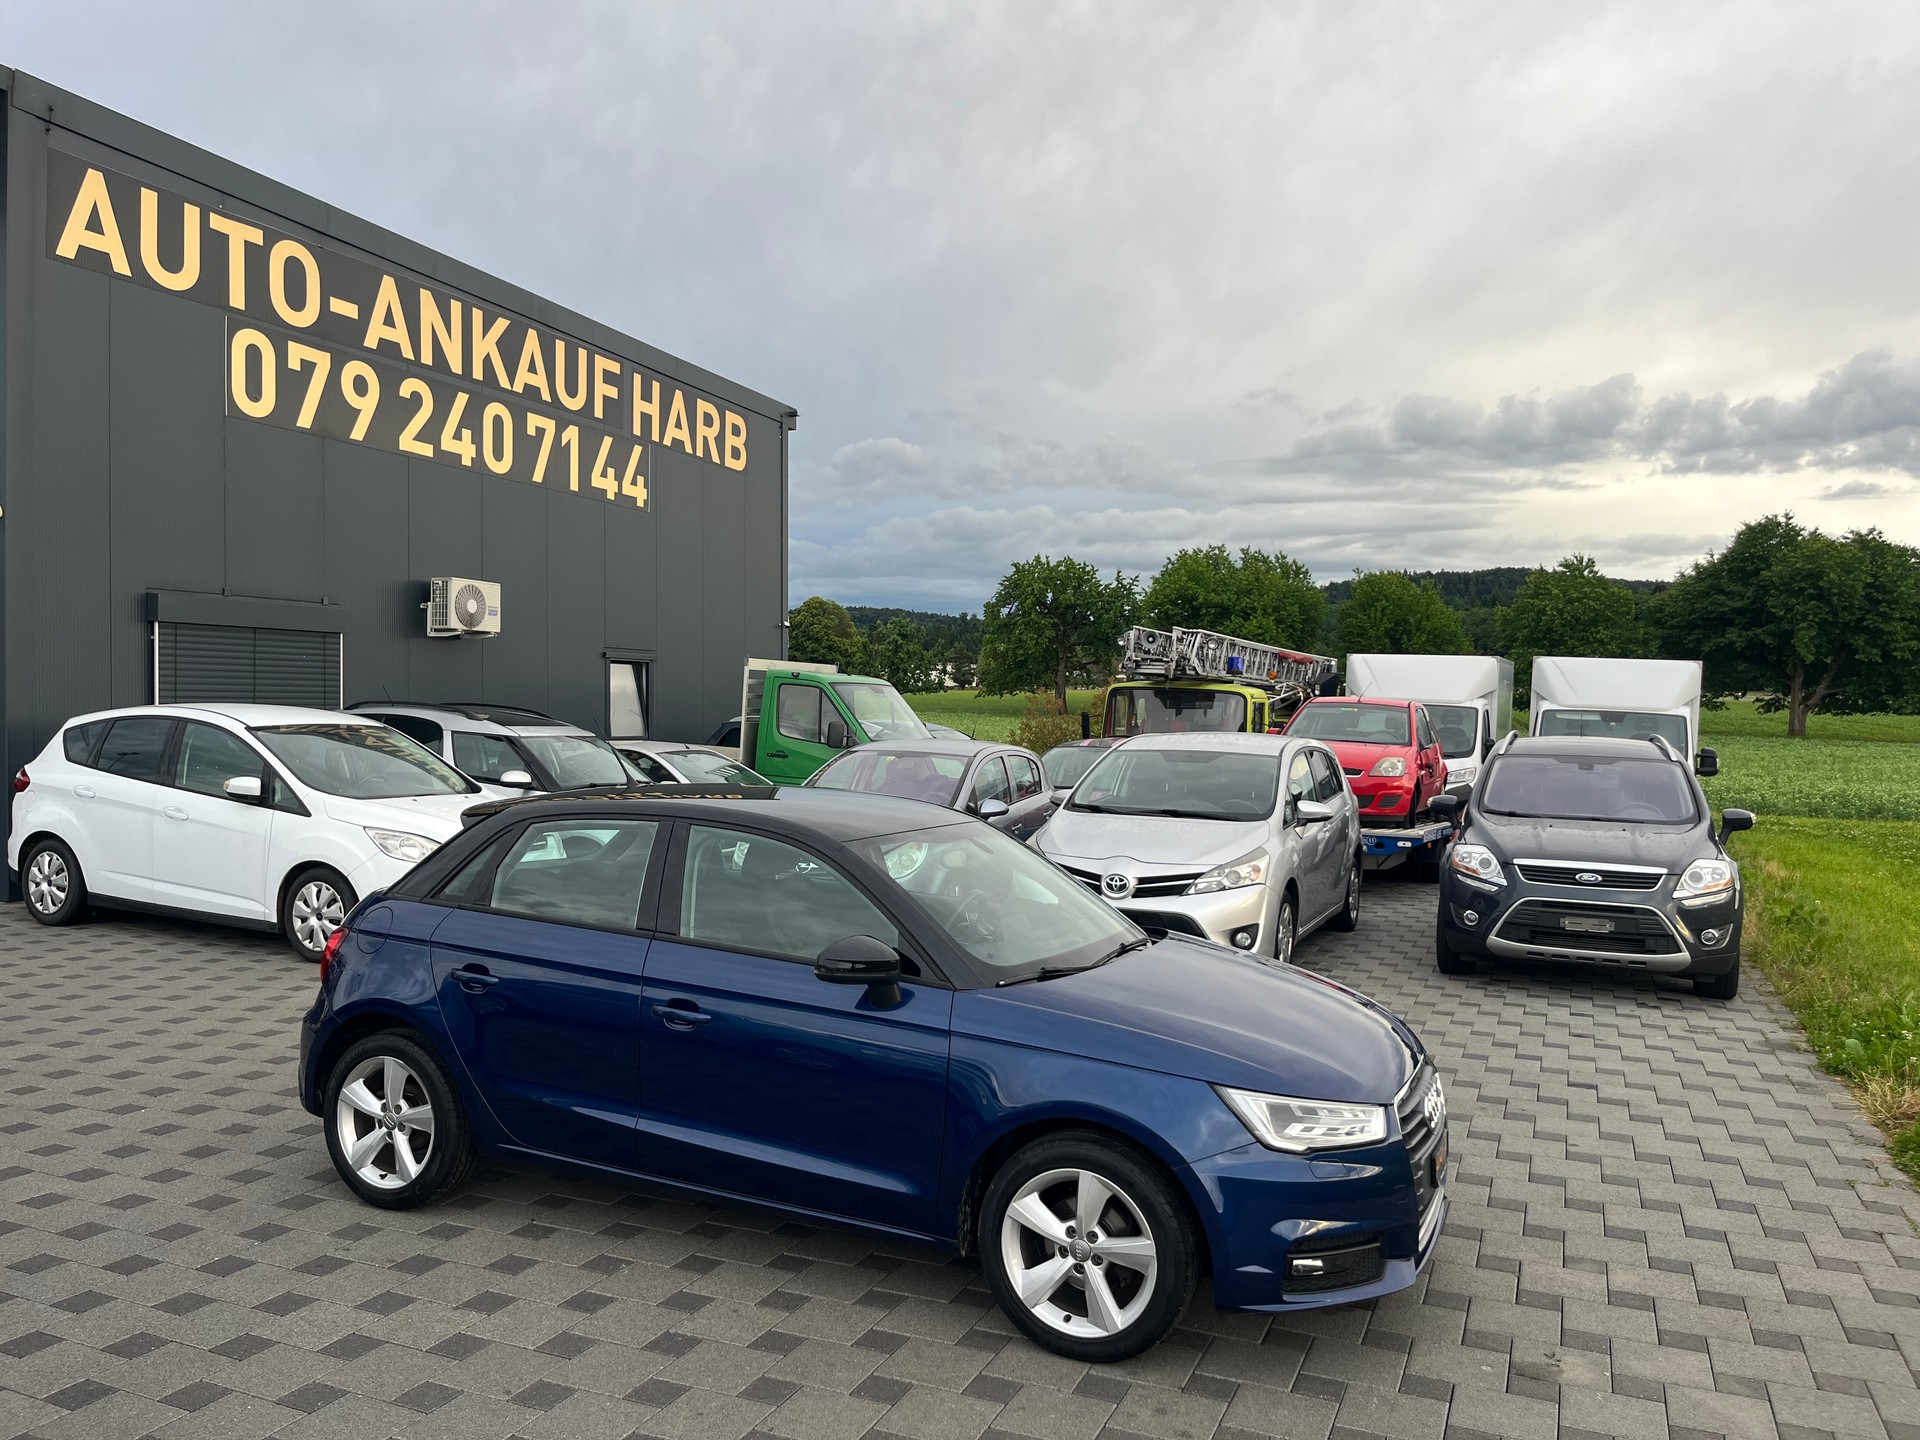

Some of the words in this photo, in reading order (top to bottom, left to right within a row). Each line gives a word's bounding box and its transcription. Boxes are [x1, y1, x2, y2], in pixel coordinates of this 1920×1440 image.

[56, 168, 622, 420] AUTO-ANKAUF
[633, 373, 748, 471] HARB
[231, 328, 380, 442] 079
[399, 377, 514, 475] 240
